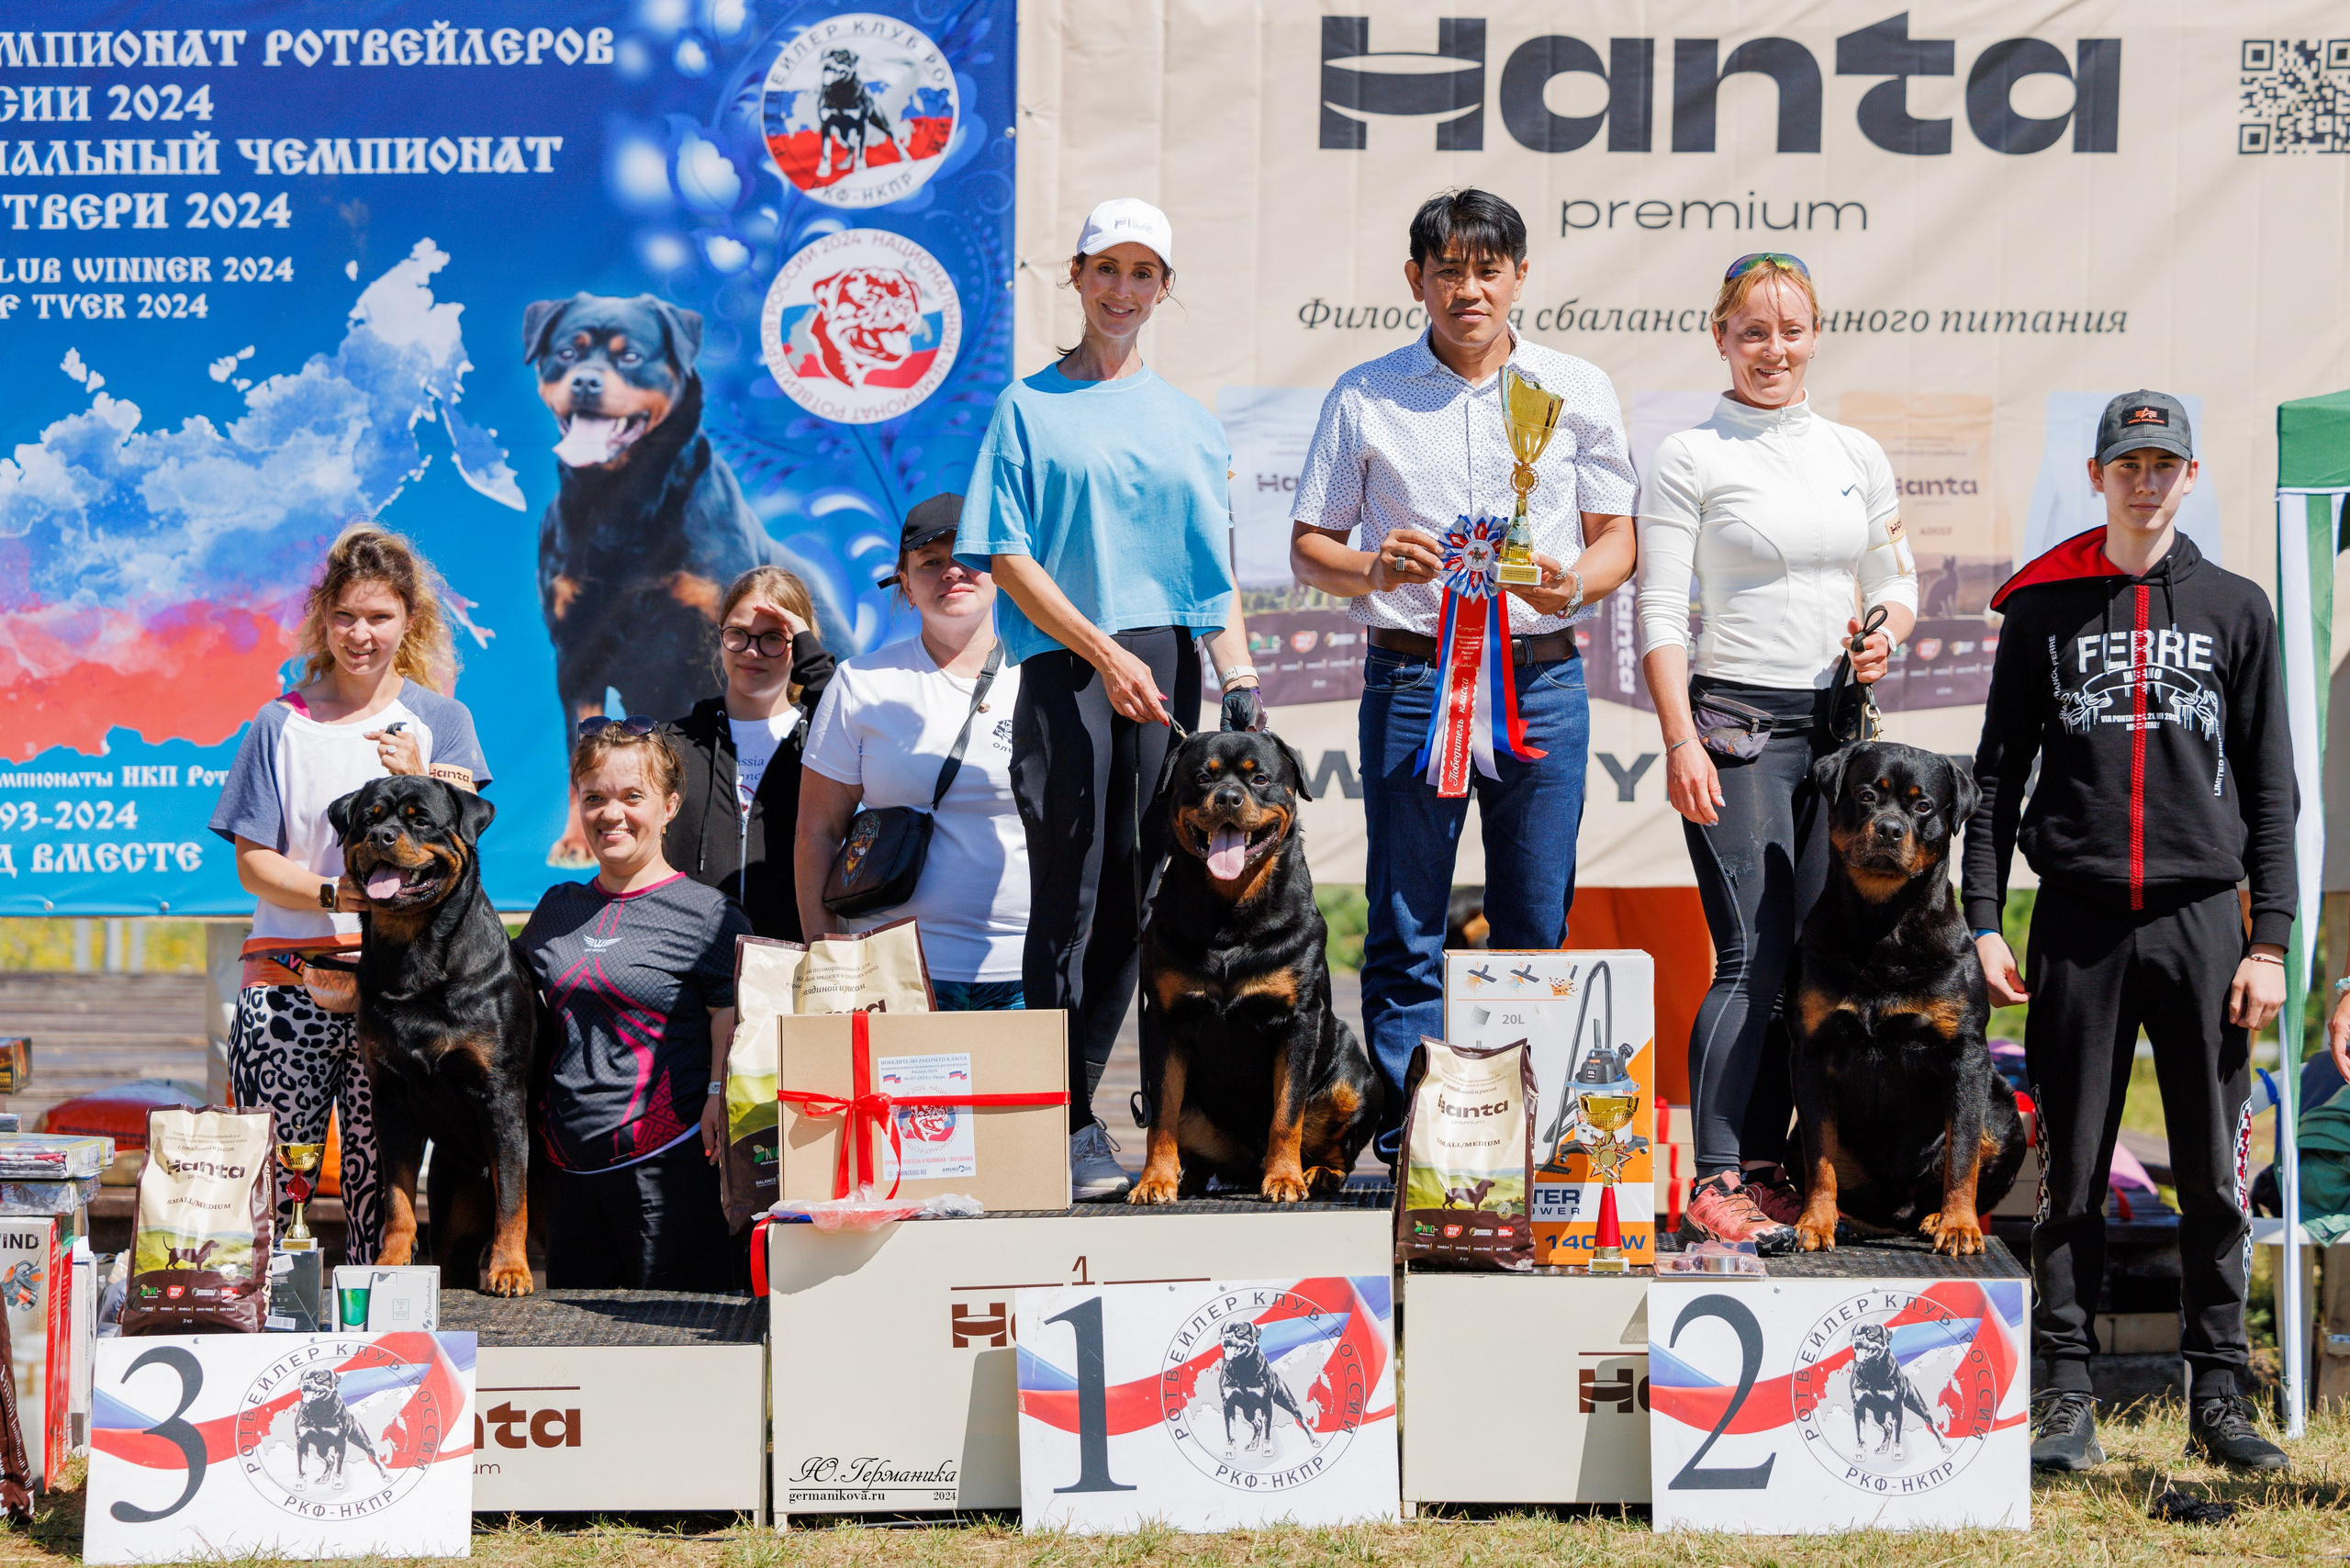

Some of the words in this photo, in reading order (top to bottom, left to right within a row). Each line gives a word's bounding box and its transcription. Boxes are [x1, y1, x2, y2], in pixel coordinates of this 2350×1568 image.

[263, 20, 614, 67] РОТВЕЙЛЕРОВ
[853, 20, 918, 48] КЛУБ
[1318, 11, 2121, 156] Hanta
[106, 84, 215, 122] 2024
[0, 130, 221, 175] АЛЬНЫЙ
[236, 136, 563, 174] ЧЕМПИОНАТ
[2, 194, 169, 230] ТВЕРИ
[185, 192, 292, 229] 2024
[1561, 190, 1868, 238] premium
[822, 231, 863, 253] 2024
[73, 256, 212, 283] WINNER
[222, 256, 295, 283] 2024
[32, 293, 126, 319] TVER
[137, 293, 208, 319] 2024
[1940, 308, 2128, 333] питания
[1896, 476, 1978, 496] anta
[2077, 629, 2213, 673] FERRE
[1449, 719, 1464, 787] Победитель
[1459, 678, 1469, 713] класса
[121, 766, 179, 787] НКП
[2214, 759, 2225, 797] LIMITED
[30, 842, 203, 873] ВМЕСТЕ
[1502, 1014, 1525, 1025] 20L
[911, 1085, 926, 1094] 2024
[166, 1159, 245, 1180] Hanta
[755, 1178, 777, 1186] BALANCE
[167, 1196, 231, 1210] SMALL/MEDIUM
[1071, 1255, 1095, 1285] 1
[1164, 1295, 1237, 1441] РОТВЕЙЛЕР
[1254, 1292, 1323, 1322] КЛУБ
[1327, 1325, 1363, 1435] РОССИИ
[1796, 1297, 1869, 1441] РОТВЕЙЛЕР
[1885, 1294, 1954, 1327] КЛУБ
[1958, 1332, 1994, 1441] РОССИИ
[1044, 1296, 1137, 1494] 1
[1668, 1294, 1777, 1490] 2
[238, 1346, 320, 1474] РОТВЕЙЛЕР
[336, 1343, 401, 1372] КЛУБ
[407, 1375, 439, 1472] РОССИИ
[110, 1346, 207, 1523] 3
[1214, 1456, 1324, 1489] РКФ-НКПР
[1845, 1461, 1954, 1493] РКФ-НКПР
[284, 1488, 394, 1518] РКФ-НКПР
